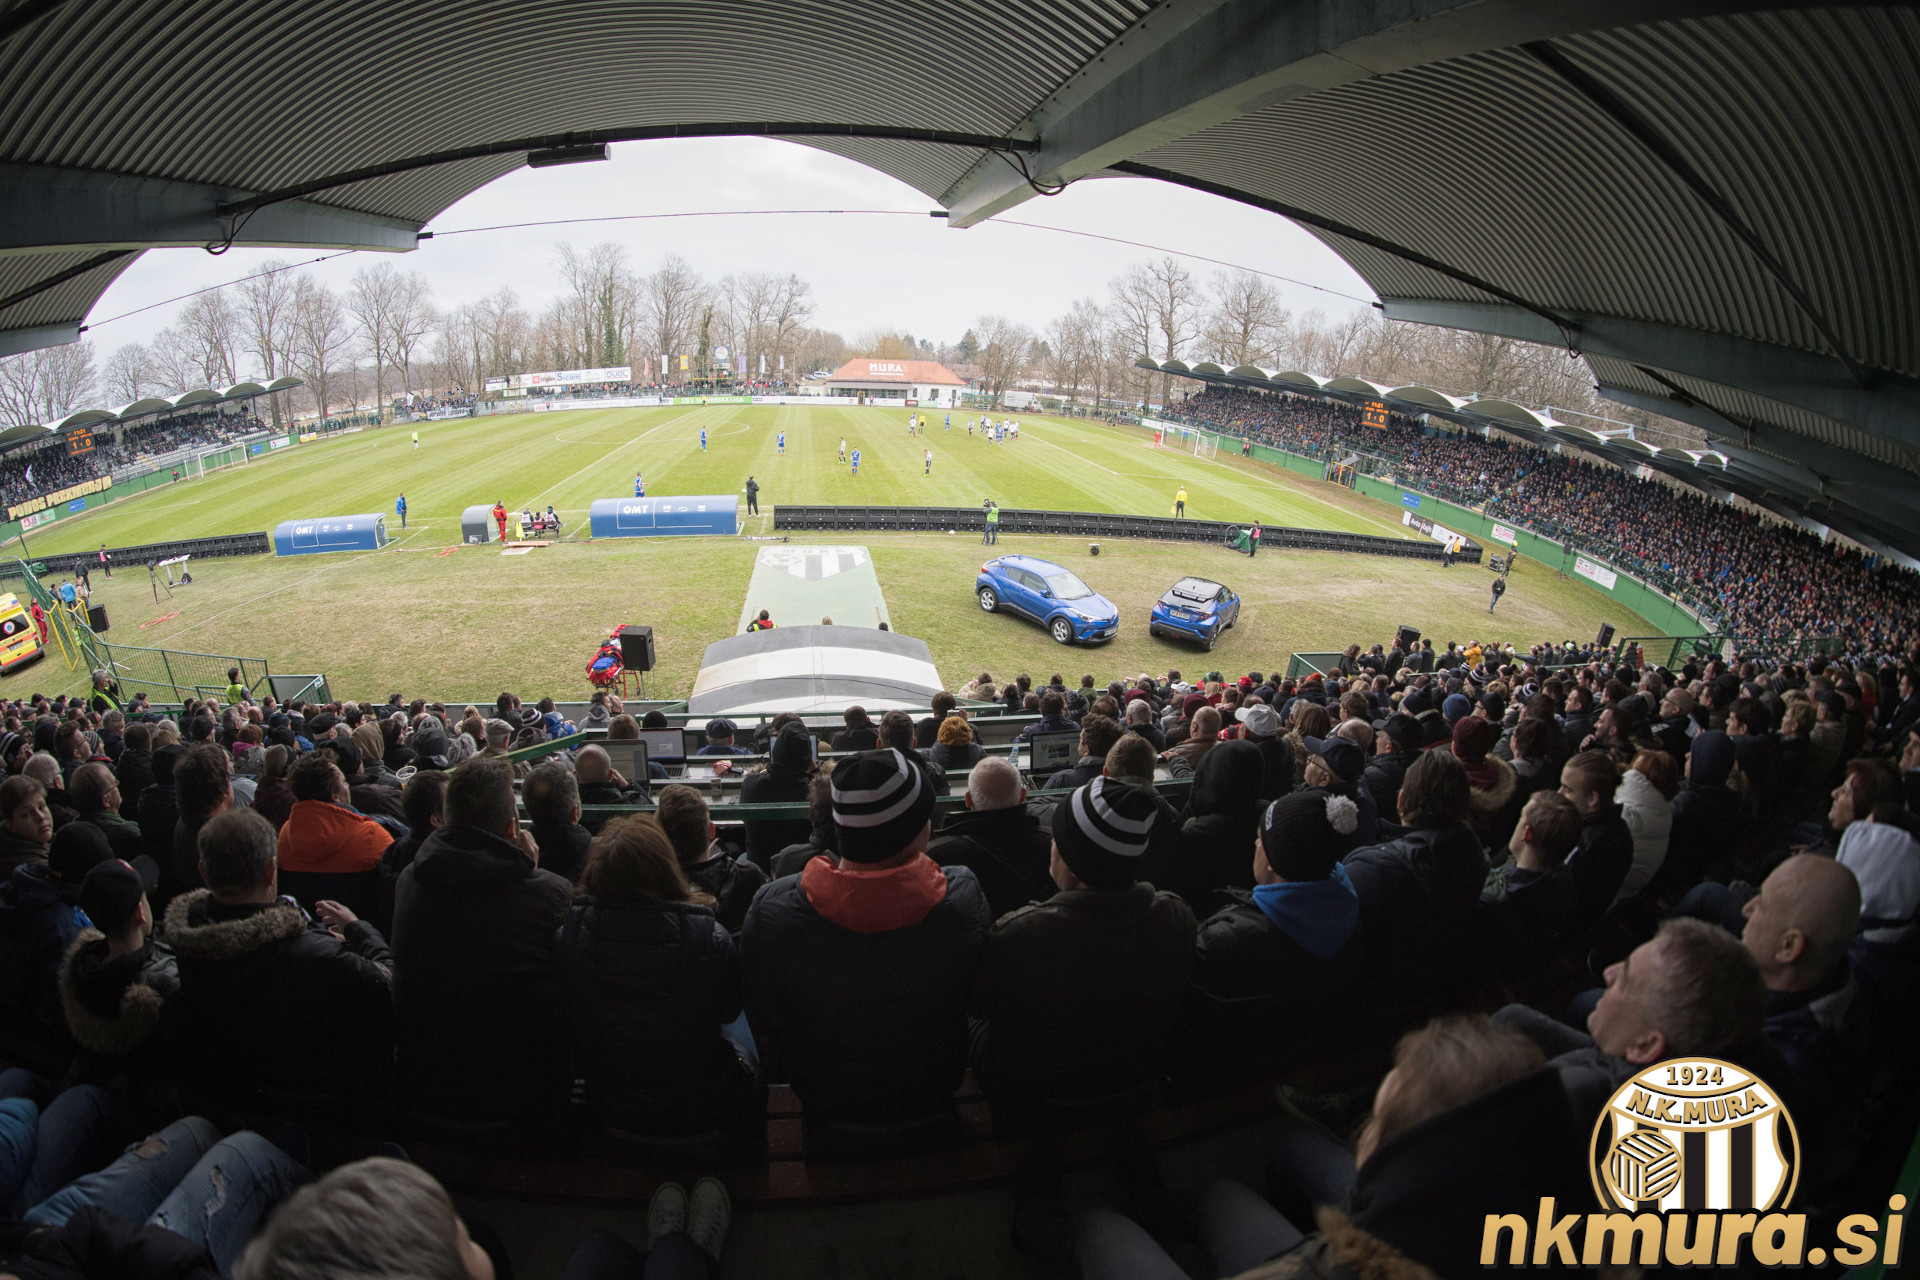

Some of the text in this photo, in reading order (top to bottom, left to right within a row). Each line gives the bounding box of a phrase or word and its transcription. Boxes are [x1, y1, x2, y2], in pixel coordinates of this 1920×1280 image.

[869, 362, 903, 372] MURA
[1378, 414, 1385, 423] 0
[85, 438, 91, 447] 0
[623, 505, 649, 514] GMT
